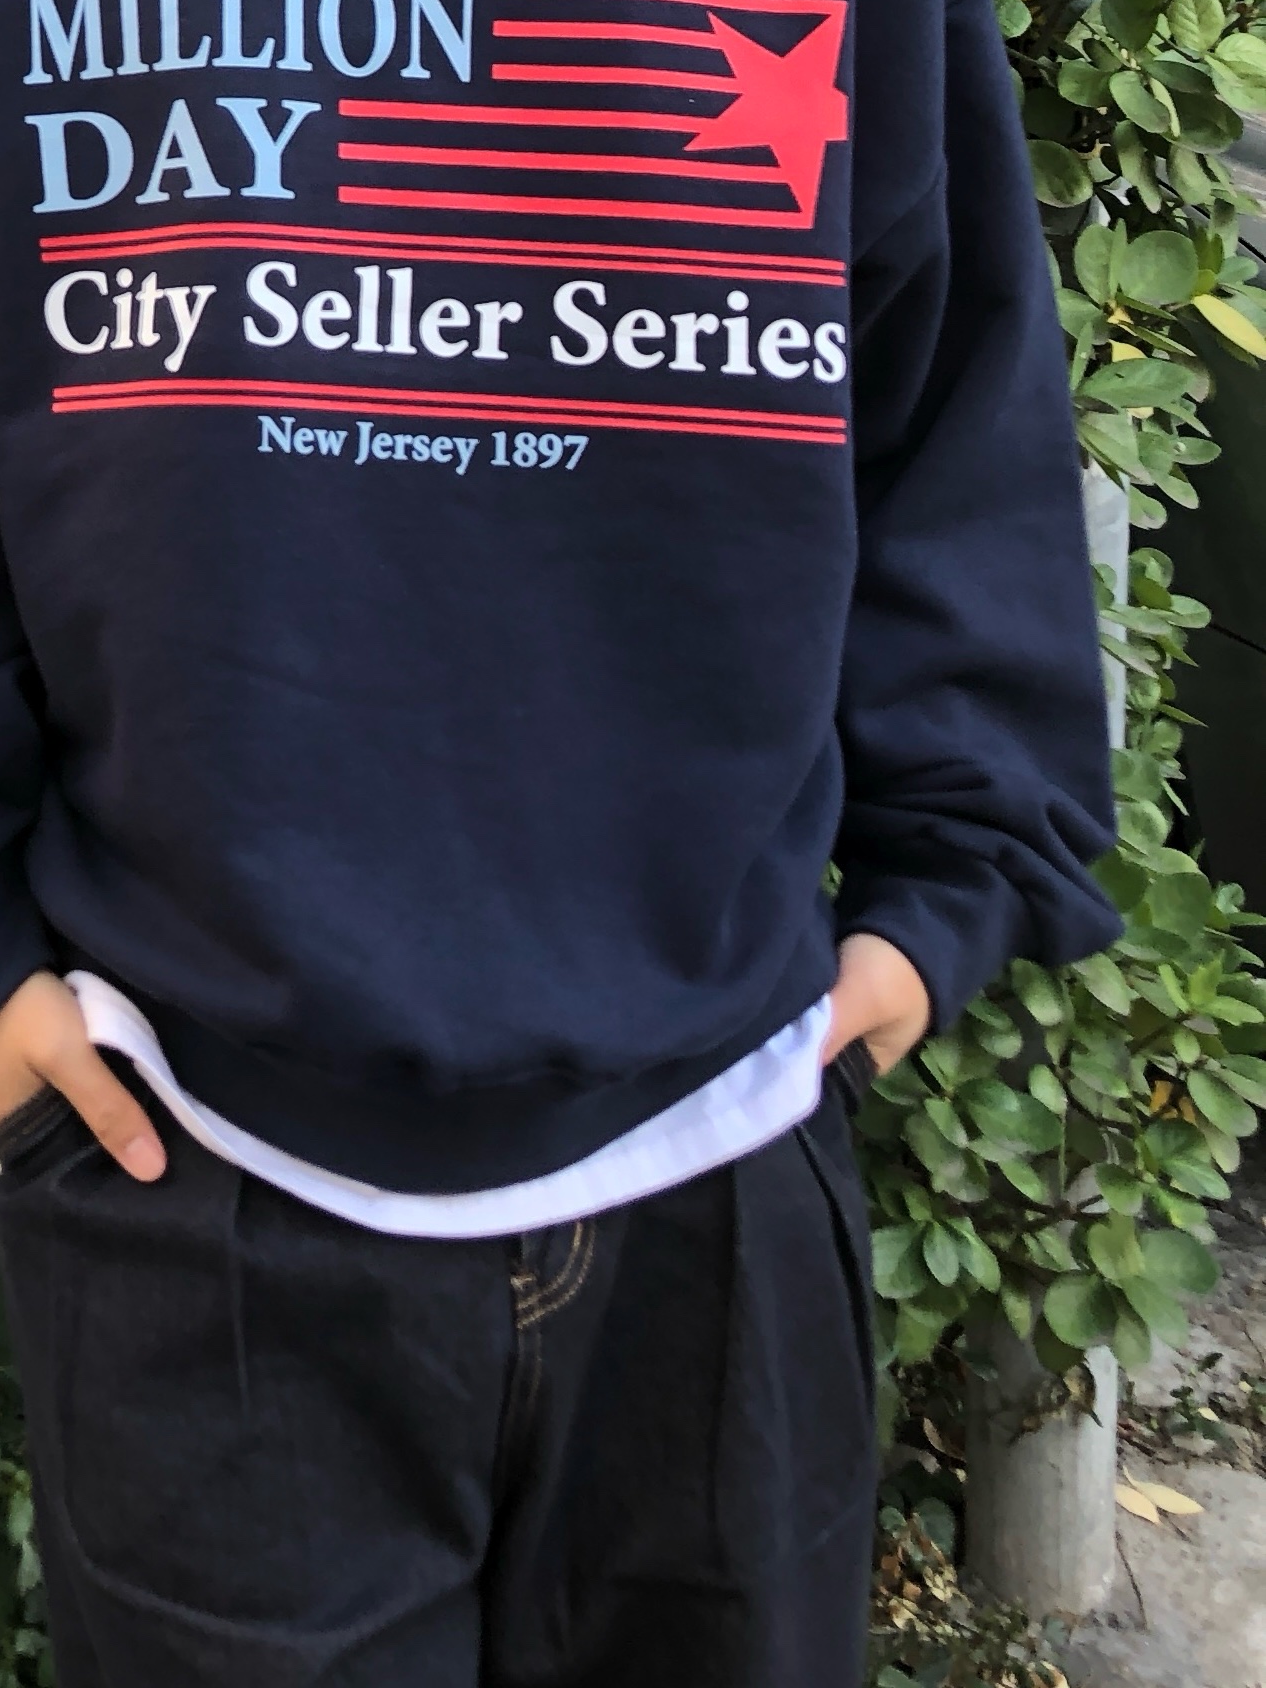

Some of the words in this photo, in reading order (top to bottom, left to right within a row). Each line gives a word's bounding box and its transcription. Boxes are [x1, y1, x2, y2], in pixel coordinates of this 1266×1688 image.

[25, 98, 321, 213] DAY
[44, 268, 216, 372] City
[243, 260, 524, 360] Seller
[550, 276, 847, 383] Series
[257, 415, 348, 457] New
[354, 421, 479, 475] Jersey
[490, 431, 589, 470] 1897
